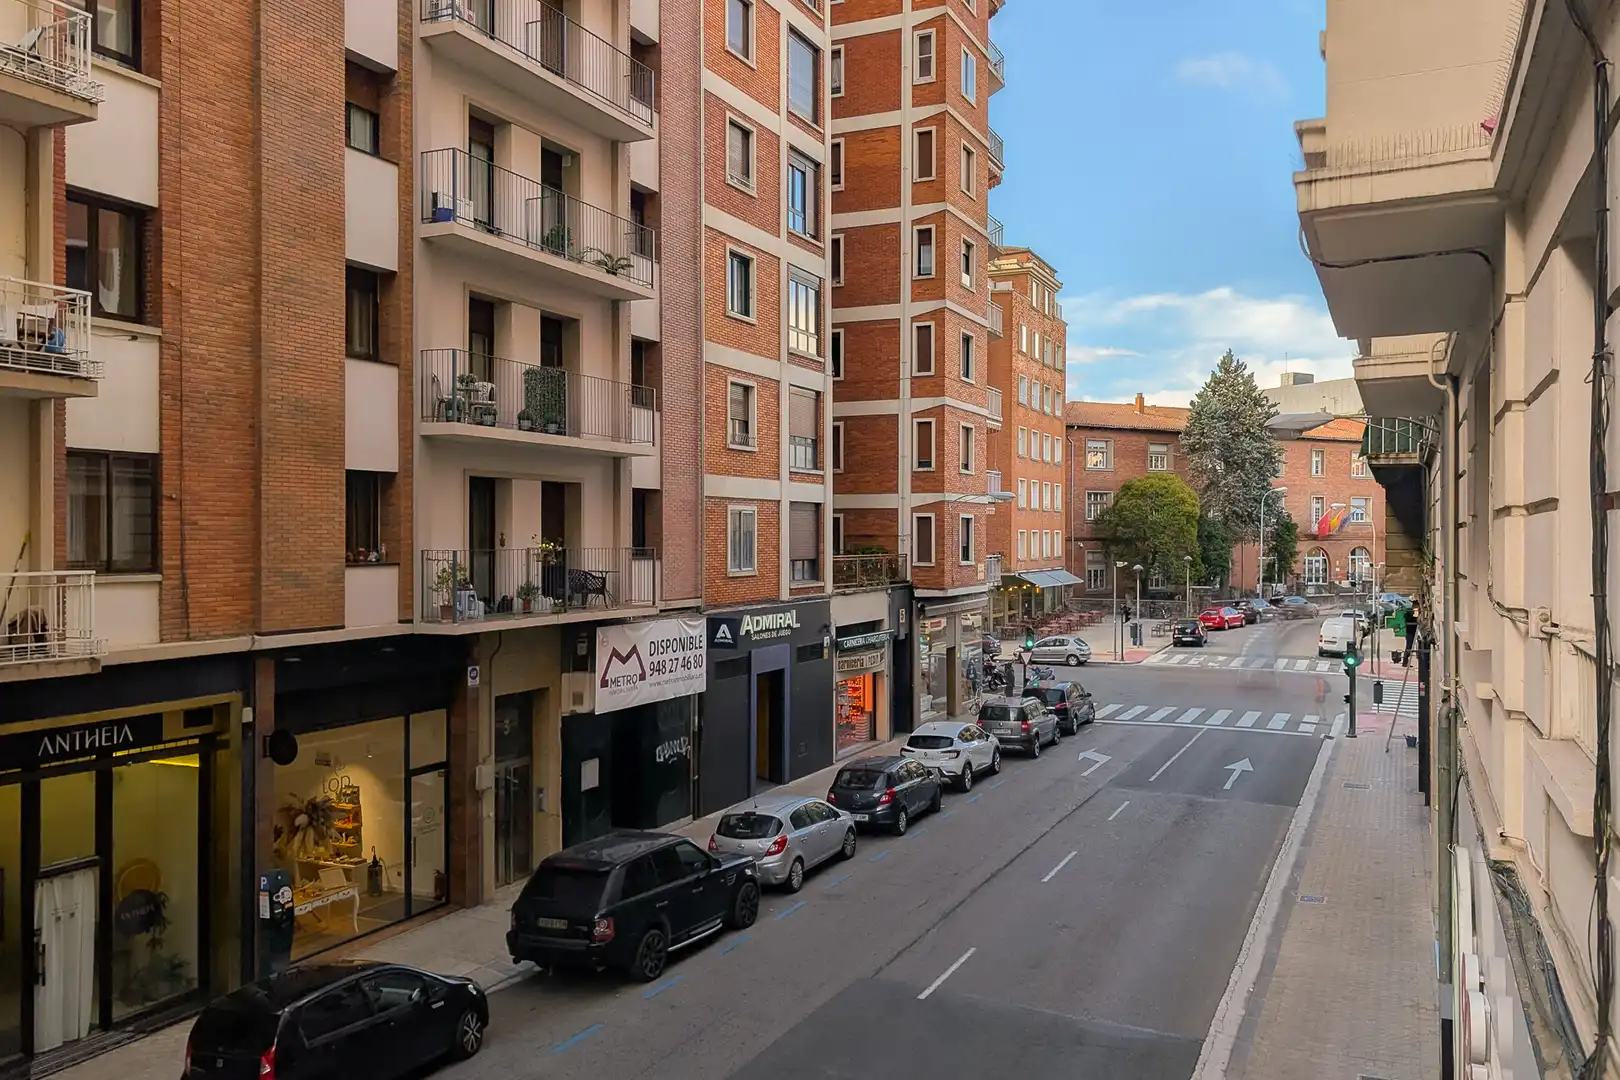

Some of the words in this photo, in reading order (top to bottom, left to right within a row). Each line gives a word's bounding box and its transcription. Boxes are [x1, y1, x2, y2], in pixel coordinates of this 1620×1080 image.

[740, 609, 800, 636] ADMIRAL
[751, 631, 771, 641] SALONES
[772, 630, 777, 638] DE
[778, 628, 791, 637] JUEGO
[649, 635, 703, 657] DISPONIBLE
[649, 660, 667, 678] 948
[668, 657, 679, 673] 27
[681, 655, 692, 671] 46
[693, 654, 703, 669] 80
[610, 673, 638, 689] METRO
[38, 723, 134, 757] ANTHEIA
[260, 876, 268, 890] P
